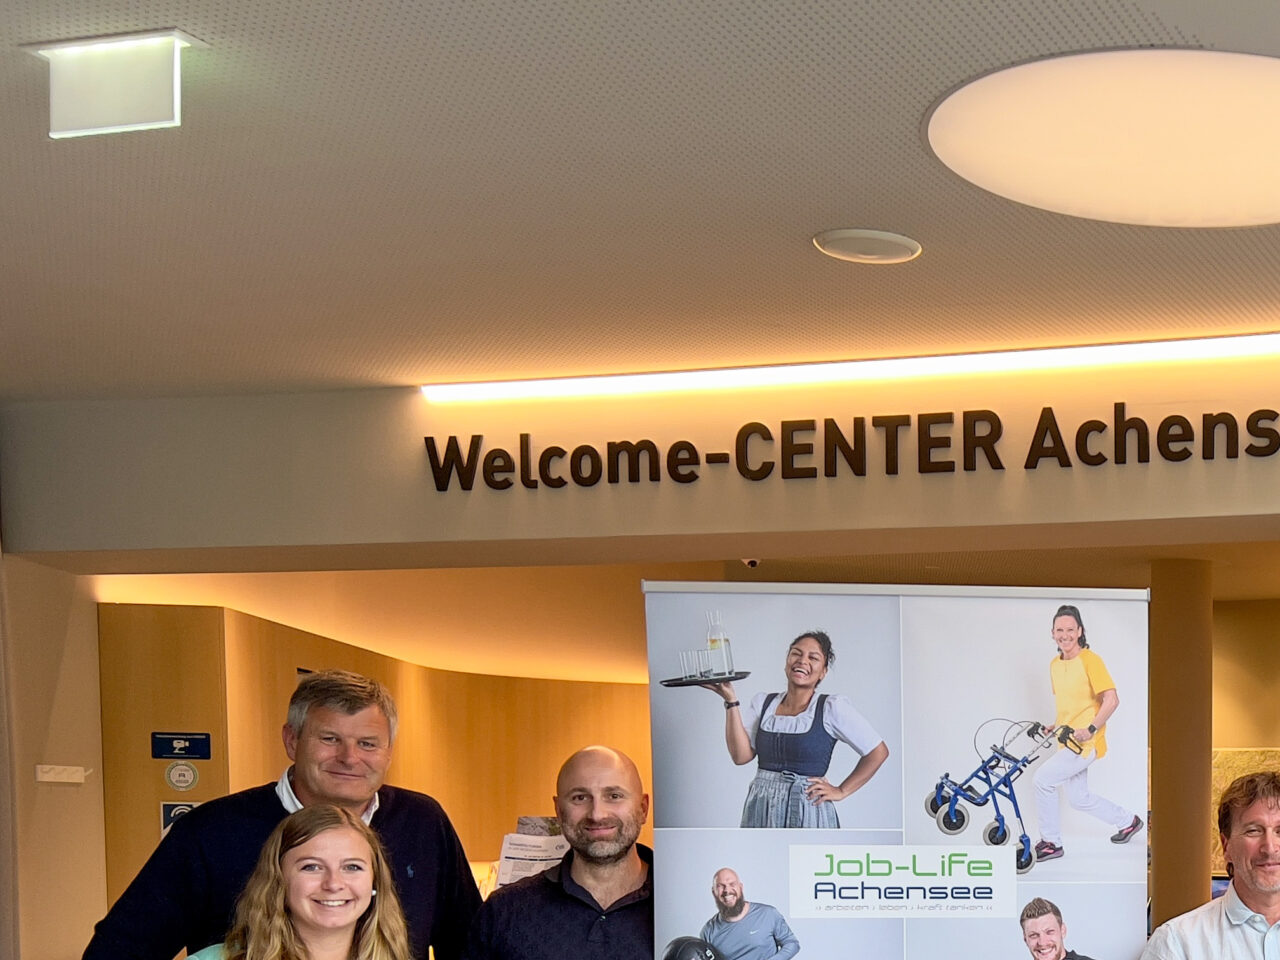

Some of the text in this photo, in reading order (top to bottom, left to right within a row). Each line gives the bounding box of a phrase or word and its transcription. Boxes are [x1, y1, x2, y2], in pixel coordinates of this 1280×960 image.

[423, 409, 1005, 493] Welcome-CENTER
[814, 853, 993, 877] Job-Life
[814, 881, 993, 900] Achensee
